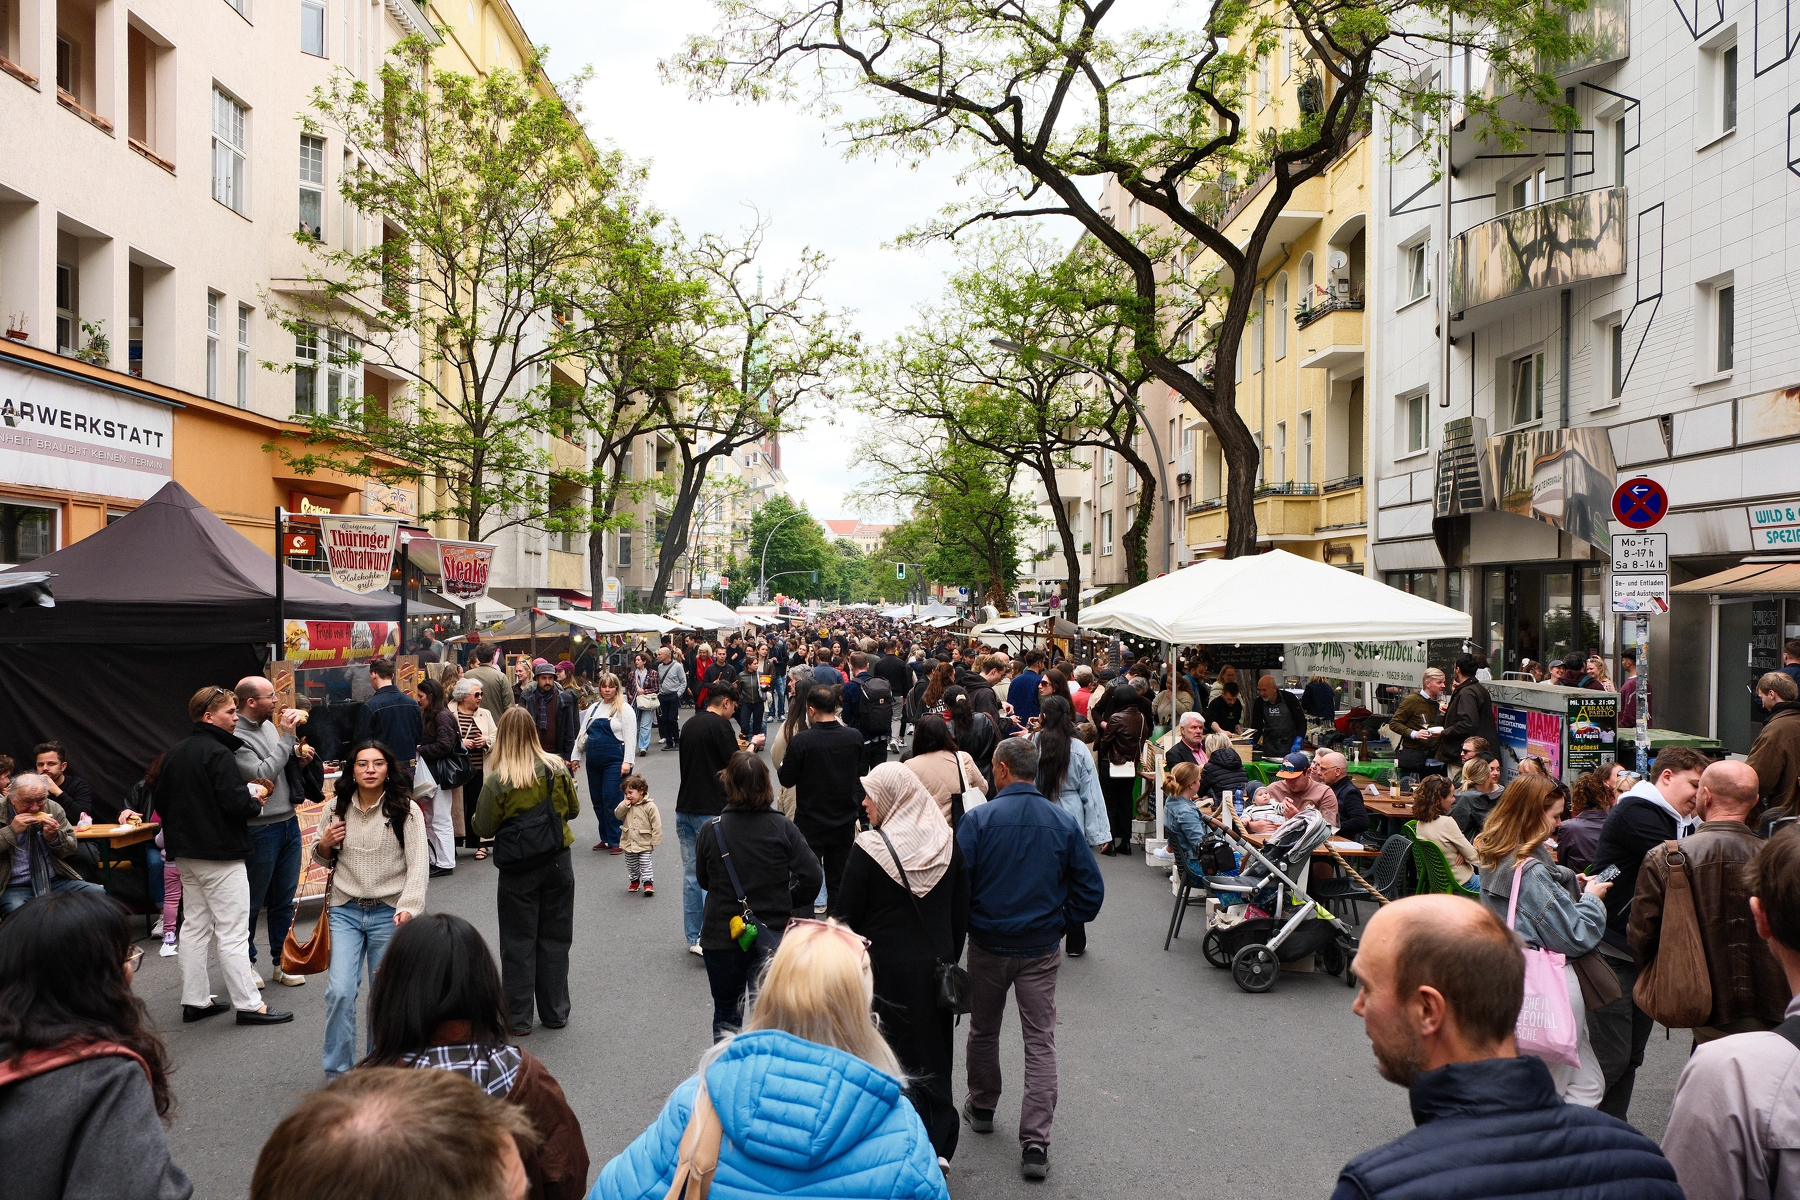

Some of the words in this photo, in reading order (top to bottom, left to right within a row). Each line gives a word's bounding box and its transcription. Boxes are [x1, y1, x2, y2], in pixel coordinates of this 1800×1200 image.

[36, 439, 88, 457] BRAUCHT
[91, 449, 127, 464] KEINEN
[130, 456, 164, 470] TERMIN
[1755, 509, 1783, 524] WILD
[1785, 507, 1796, 521] &
[340, 522, 377, 532] Original
[330, 529, 390, 551] Thüringer
[329, 545, 392, 571] Rostbratwurst
[1615, 560, 1628, 569] Sa
[1658, 560, 1664, 568] h
[443, 556, 488, 584] Steaks
[1498, 712, 1516, 721] BERLIN
[1498, 719, 1527, 730] MEDITATION
[1527, 711, 1560, 735] MAMA
[1498, 726, 1513, 734] WEEK
